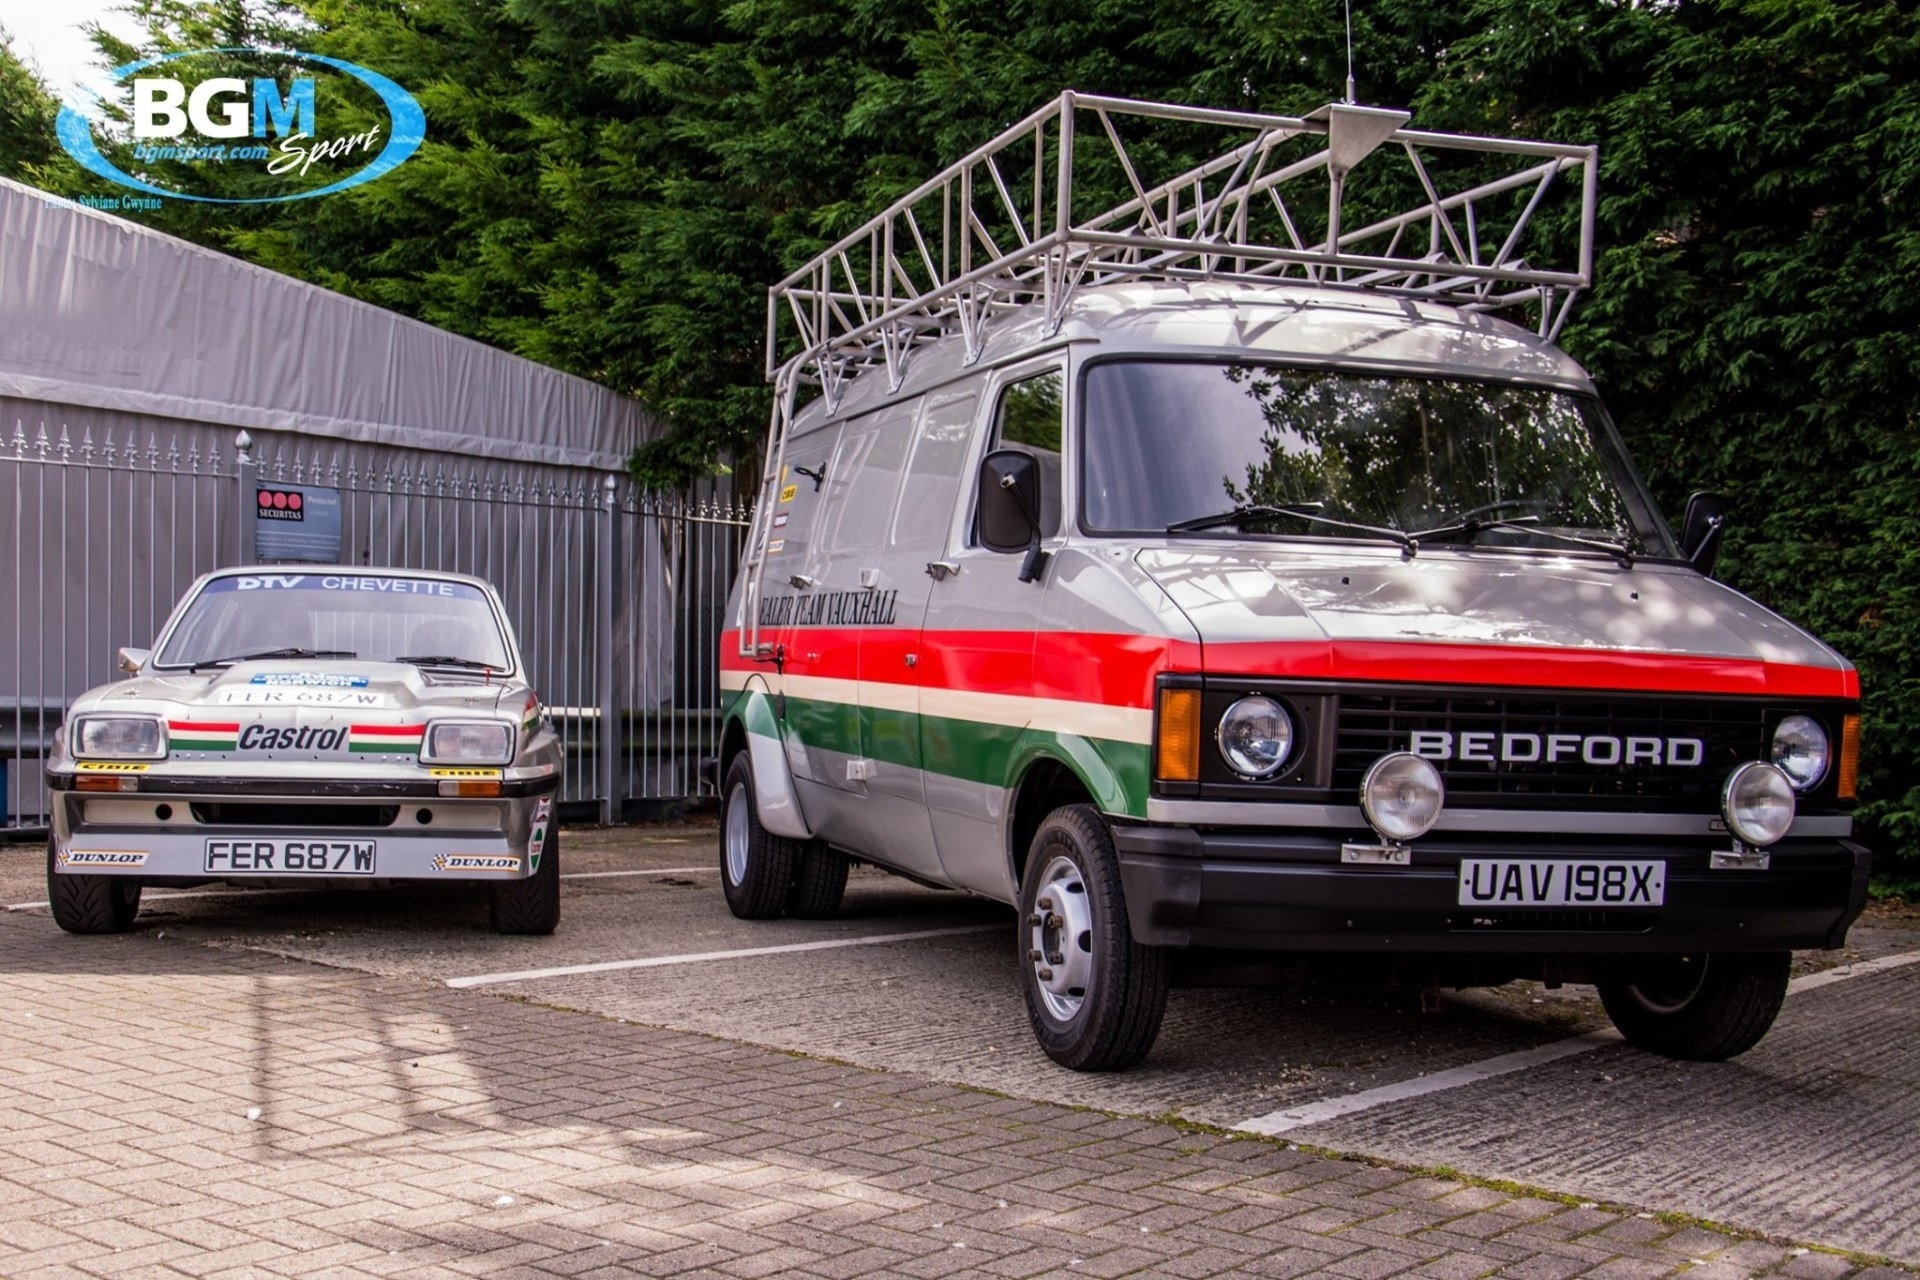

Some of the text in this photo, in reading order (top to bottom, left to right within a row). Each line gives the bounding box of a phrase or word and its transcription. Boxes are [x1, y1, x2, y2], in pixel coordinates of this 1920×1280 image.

[259, 508, 302, 519] SECURITAS
[237, 576, 455, 596] DTV CHEVETTE
[758, 589, 899, 626] EALER TEAM VAUXHALL
[226, 692, 378, 704] FER 687W
[239, 724, 349, 751] Castrol
[1410, 731, 1704, 766] BEDFORD
[72, 853, 144, 863] DUNLOP
[207, 842, 374, 871] FER 687W
[449, 857, 518, 868] DUNLOP
[1471, 863, 1654, 903] UAV 198X
